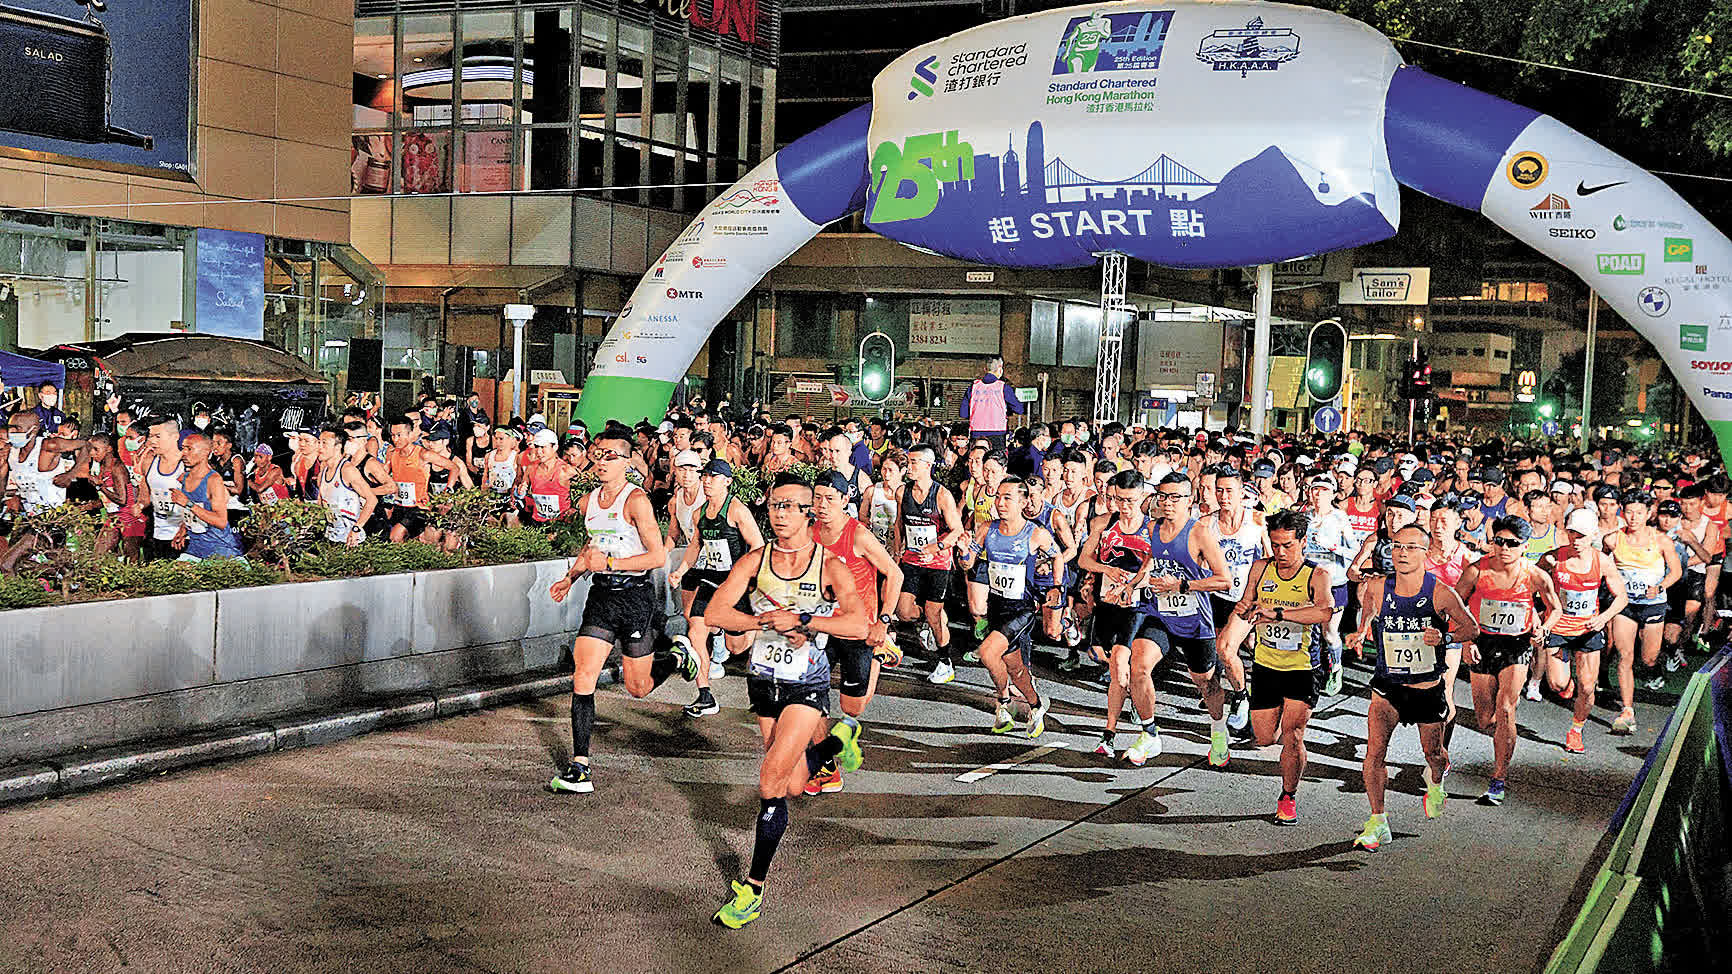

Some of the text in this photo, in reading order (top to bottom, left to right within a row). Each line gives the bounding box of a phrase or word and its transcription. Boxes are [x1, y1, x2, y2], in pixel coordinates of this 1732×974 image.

[24, 46, 64, 62] SALAD
[950, 42, 1028, 65] standard
[947, 53, 1029, 77] chartered
[1218, 61, 1273, 70] H.K.A.A.A.
[943, 71, 1002, 93] 渣打銀行
[1048, 77, 1157, 93] Standard Chartered
[1046, 90, 1154, 105] Hong Kong Marathon
[1086, 101, 1154, 113] 渣打香港馬拉松
[869, 129, 976, 224] 25th
[988, 209, 1206, 245] 起 START 點
[1549, 228, 1596, 239] SEIKO
[1668, 244, 1690, 256] GP
[1371, 276, 1404, 288] Sam's
[678, 290, 703, 299] MTR
[1365, 285, 1398, 298] tailor
[647, 314, 678, 323] ANESSA
[636, 355, 647, 364] 5G
[493, 480, 505, 488] 423
[158, 501, 176, 512] 357
[879, 528, 895, 541] 343
[912, 536, 929, 546] 161
[994, 575, 1015, 589] 407
[1166, 595, 1187, 608] 102
[1566, 600, 1588, 610] 436
[1489, 612, 1515, 626] 170
[1265, 624, 1291, 641] 382
[765, 644, 794, 665] 366
[1393, 648, 1423, 663] 791
